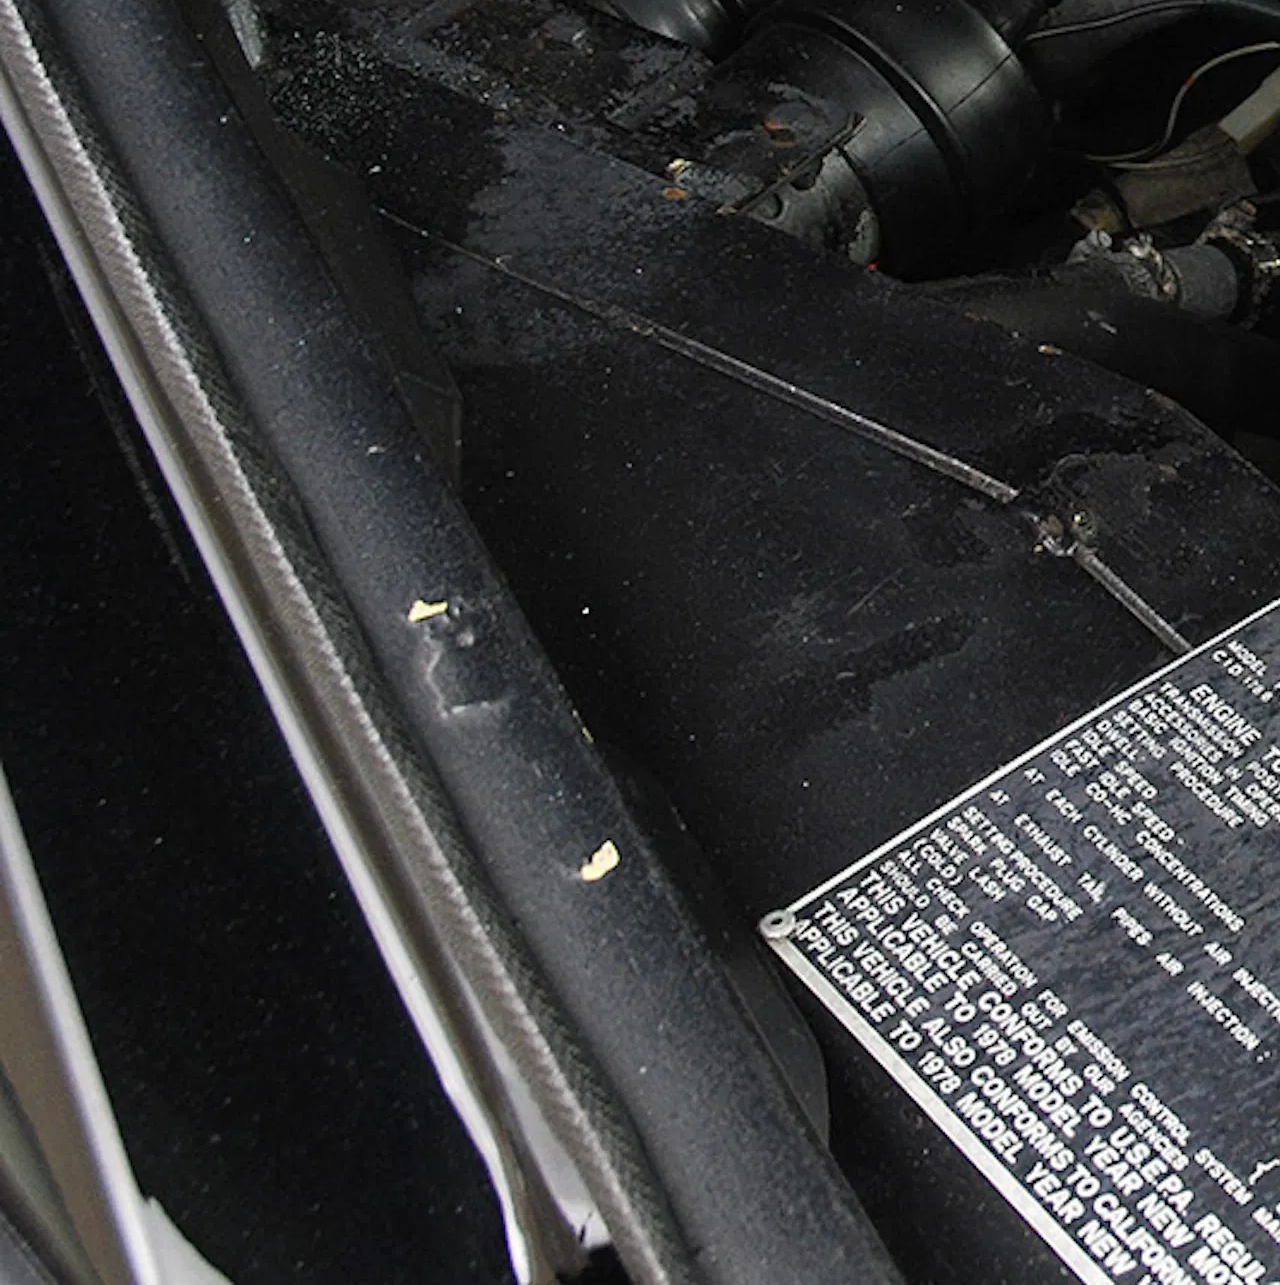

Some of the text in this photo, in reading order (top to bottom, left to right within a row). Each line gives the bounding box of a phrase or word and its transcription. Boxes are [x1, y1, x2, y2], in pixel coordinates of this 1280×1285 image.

[1189, 683, 1262, 747] ENGINE
[1226, 639, 1267, 677] MODEL
[1080, 727, 1158, 800] IDLE SPEED
[1095, 718, 1139, 761] DWELL
[1112, 709, 1244, 828] SETTING PROCEDURE
[1127, 698, 1270, 827] BASIC IGNITION TIMING
[1143, 692, 1223, 764] ACCESSORIES
[1224, 764, 1244, 781] IN
[1159, 681, 1243, 759] TRANSMISSION
[1049, 748, 1082, 778] IDLE
[1135, 829, 1245, 932] CONCENTRATIONS
[1064, 738, 1175, 842] FAST IDLE SPEED
[912, 837, 963, 886] (COLD)
[929, 827, 1007, 902] VALVE LASH
[946, 815, 1058, 922] SPARK PLUG GAP
[962, 805, 1084, 921] SETTING PROCEDURE
[989, 789, 1010, 806] AT
[1013, 812, 1072, 867] EXHAUST
[1111, 906, 1153, 946] PIPES
[1155, 952, 1184, 977] AIR
[1022, 767, 1046, 785] AT
[1044, 788, 1083, 824] EACH
[1082, 824, 1144, 882] CYLINDER
[1143, 881, 1204, 936] WITHOUT
[1202, 941, 1233, 966] AIR
[813, 899, 860, 946] THIS
[852, 940, 931, 1018] VEHICLE
[920, 1016, 976, 1067] ALSO
[970, 1065, 1074, 1171] CONFORMS
[1065, 1162, 1101, 1198] TO
[836, 887, 1196, 1248] APPLICABLE TO 1978 MODEL YEAR NEW
[879, 859, 1190, 1171] SHOULD BE CARRIED OUT BY OUR AGENCIES
[896, 849, 1253, 1205] ALL CHECK OPERATION FOR EMISSION CONTROL SYSTEM
[789, 918, 1137, 1276] APPLICABLE TO 1978 MODEL YEAR NEW
[859, 869, 906, 915] THIS
[901, 911, 982, 992] VEHICLE
[977, 990, 1084, 1096] CONFORMS
[1078, 1093, 1113, 1128] TO
[1193, 1213, 1280, 1285] REGUL
